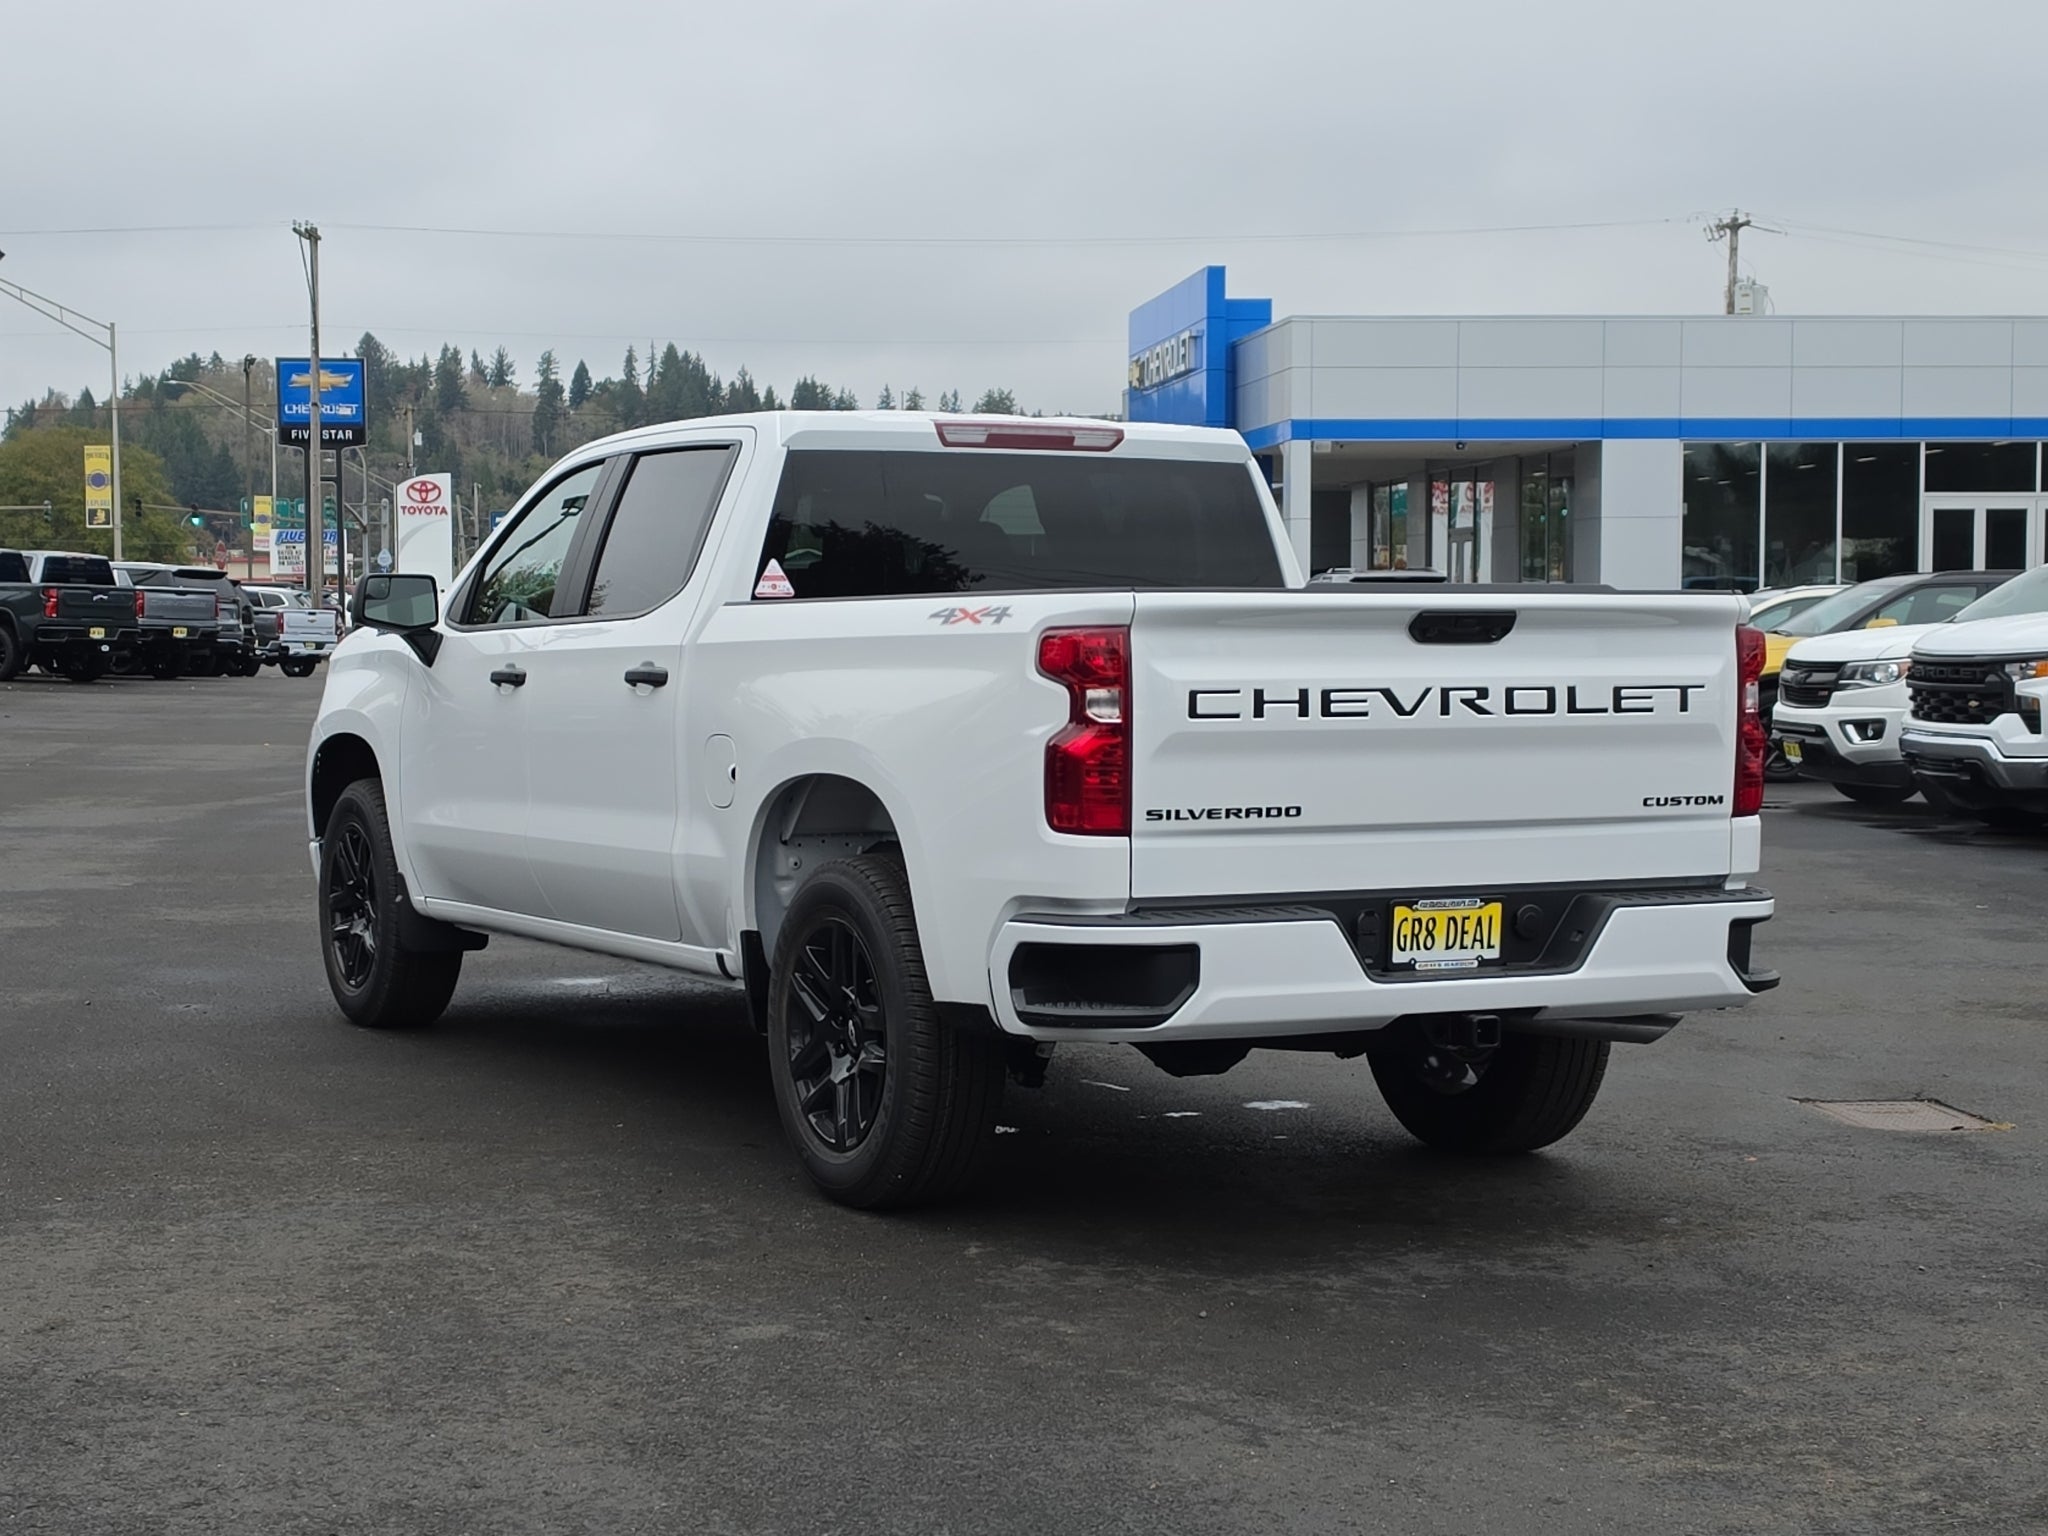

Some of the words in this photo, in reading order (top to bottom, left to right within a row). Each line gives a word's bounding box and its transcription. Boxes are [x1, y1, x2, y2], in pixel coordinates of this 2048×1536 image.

[1143, 329, 1191, 387] CHEVROLET
[291, 429, 310, 440] FIV
[321, 429, 353, 440] STAR
[400, 505, 448, 516] TOYOTA
[1188, 684, 1705, 719] CHEVROLET
[1642, 795, 1724, 807] CUSTOM
[1145, 806, 1302, 821] SILVERADO
[1396, 916, 1437, 952] GR8
[1444, 915, 1496, 951] DEAL
